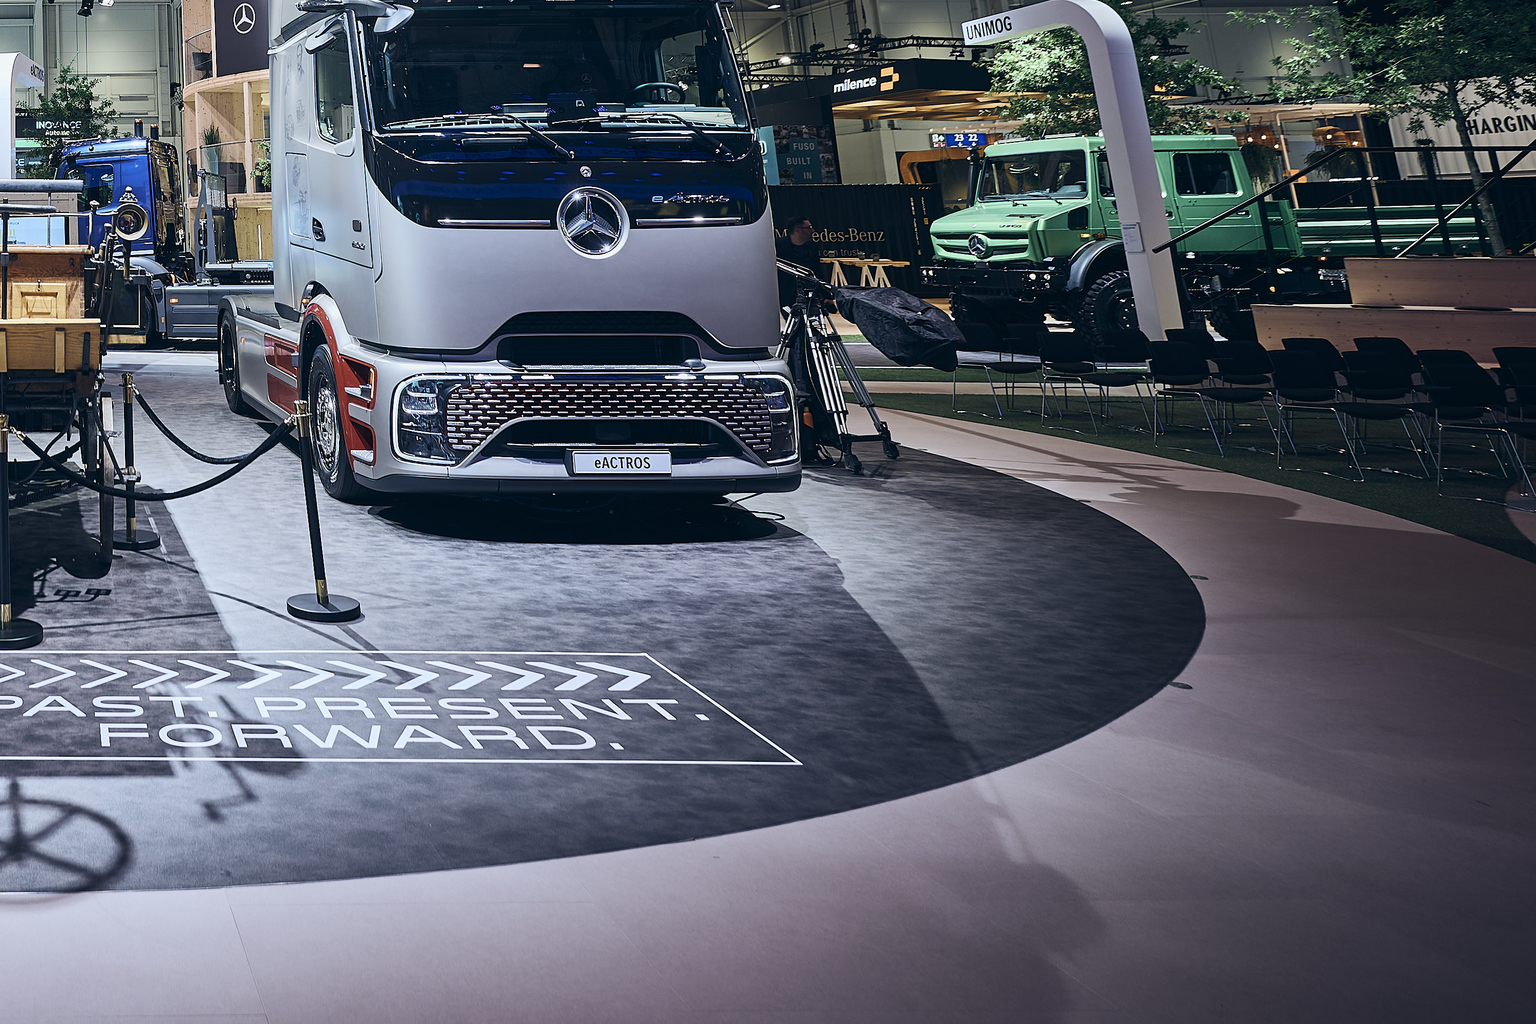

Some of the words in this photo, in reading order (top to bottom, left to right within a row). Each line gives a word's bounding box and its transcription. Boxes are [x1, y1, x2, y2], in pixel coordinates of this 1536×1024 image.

[966, 16, 1013, 40] UNIMOG
[833, 76, 877, 93] milence
[1466, 114, 1536, 135] HARGIN
[954, 133, 964, 142] 23
[968, 133, 979, 142] 22
[792, 142, 815, 151] FUSO
[786, 157, 811, 165] BUILT
[803, 171, 813, 180] IN
[775, 228, 885, 243] Medes-Benz
[594, 456, 651, 469] eACTROS
[255, 697, 711, 722] PRESENT.
[99, 723, 624, 751] FORWARD.
